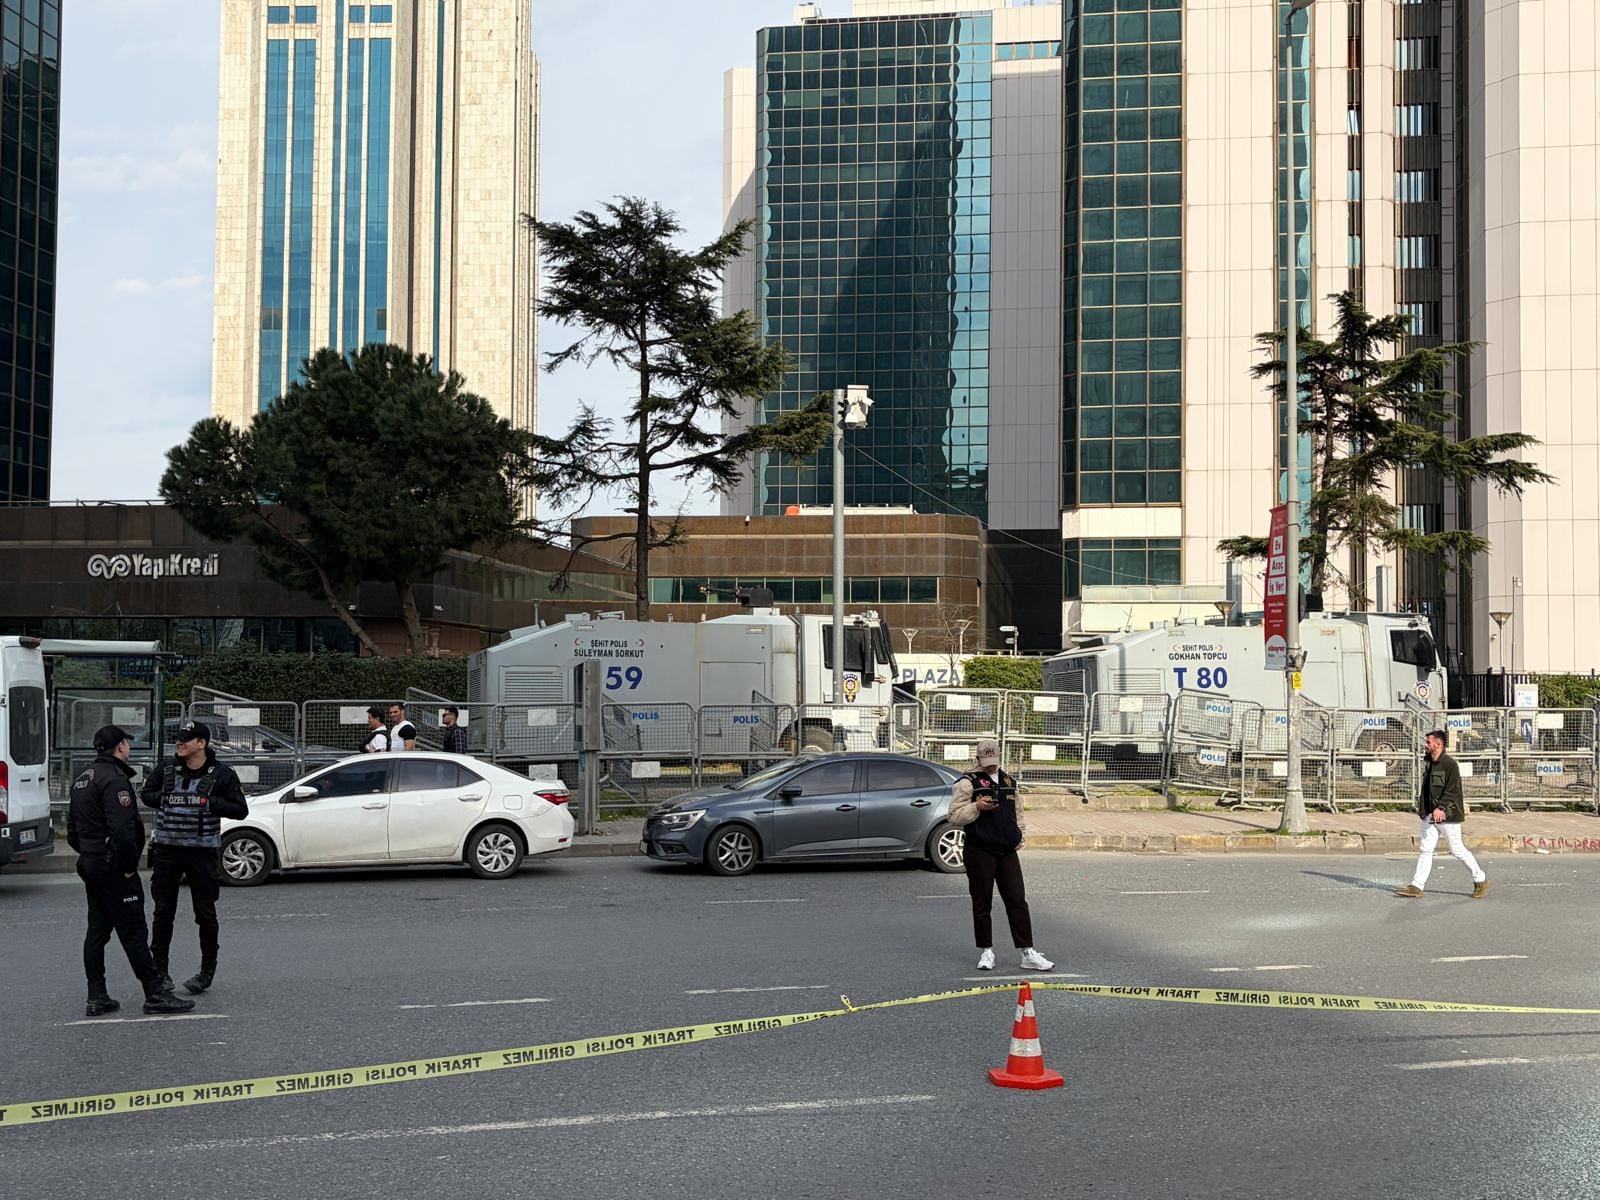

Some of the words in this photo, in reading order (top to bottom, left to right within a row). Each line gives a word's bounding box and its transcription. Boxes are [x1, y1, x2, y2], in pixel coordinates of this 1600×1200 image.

[610, 640, 628, 648] POLİS
[615, 649, 645, 658] SORKUT
[605, 665, 643, 690] 59
[902, 668, 961, 684] PLAZA
[1173, 667, 1187, 689] T
[1197, 667, 1228, 689] 80
[1206, 704, 1232, 714] POLİS
[632, 711, 659, 720] POLİS
[733, 714, 760, 724] POLİS
[1363, 718, 1386, 727] POLİS
[1448, 718, 1471, 727] POLİS
[1201, 753, 1226, 763] POLİS
[1537, 765, 1562, 773] POLİS
[169, 794, 186, 805] ÖZEL
